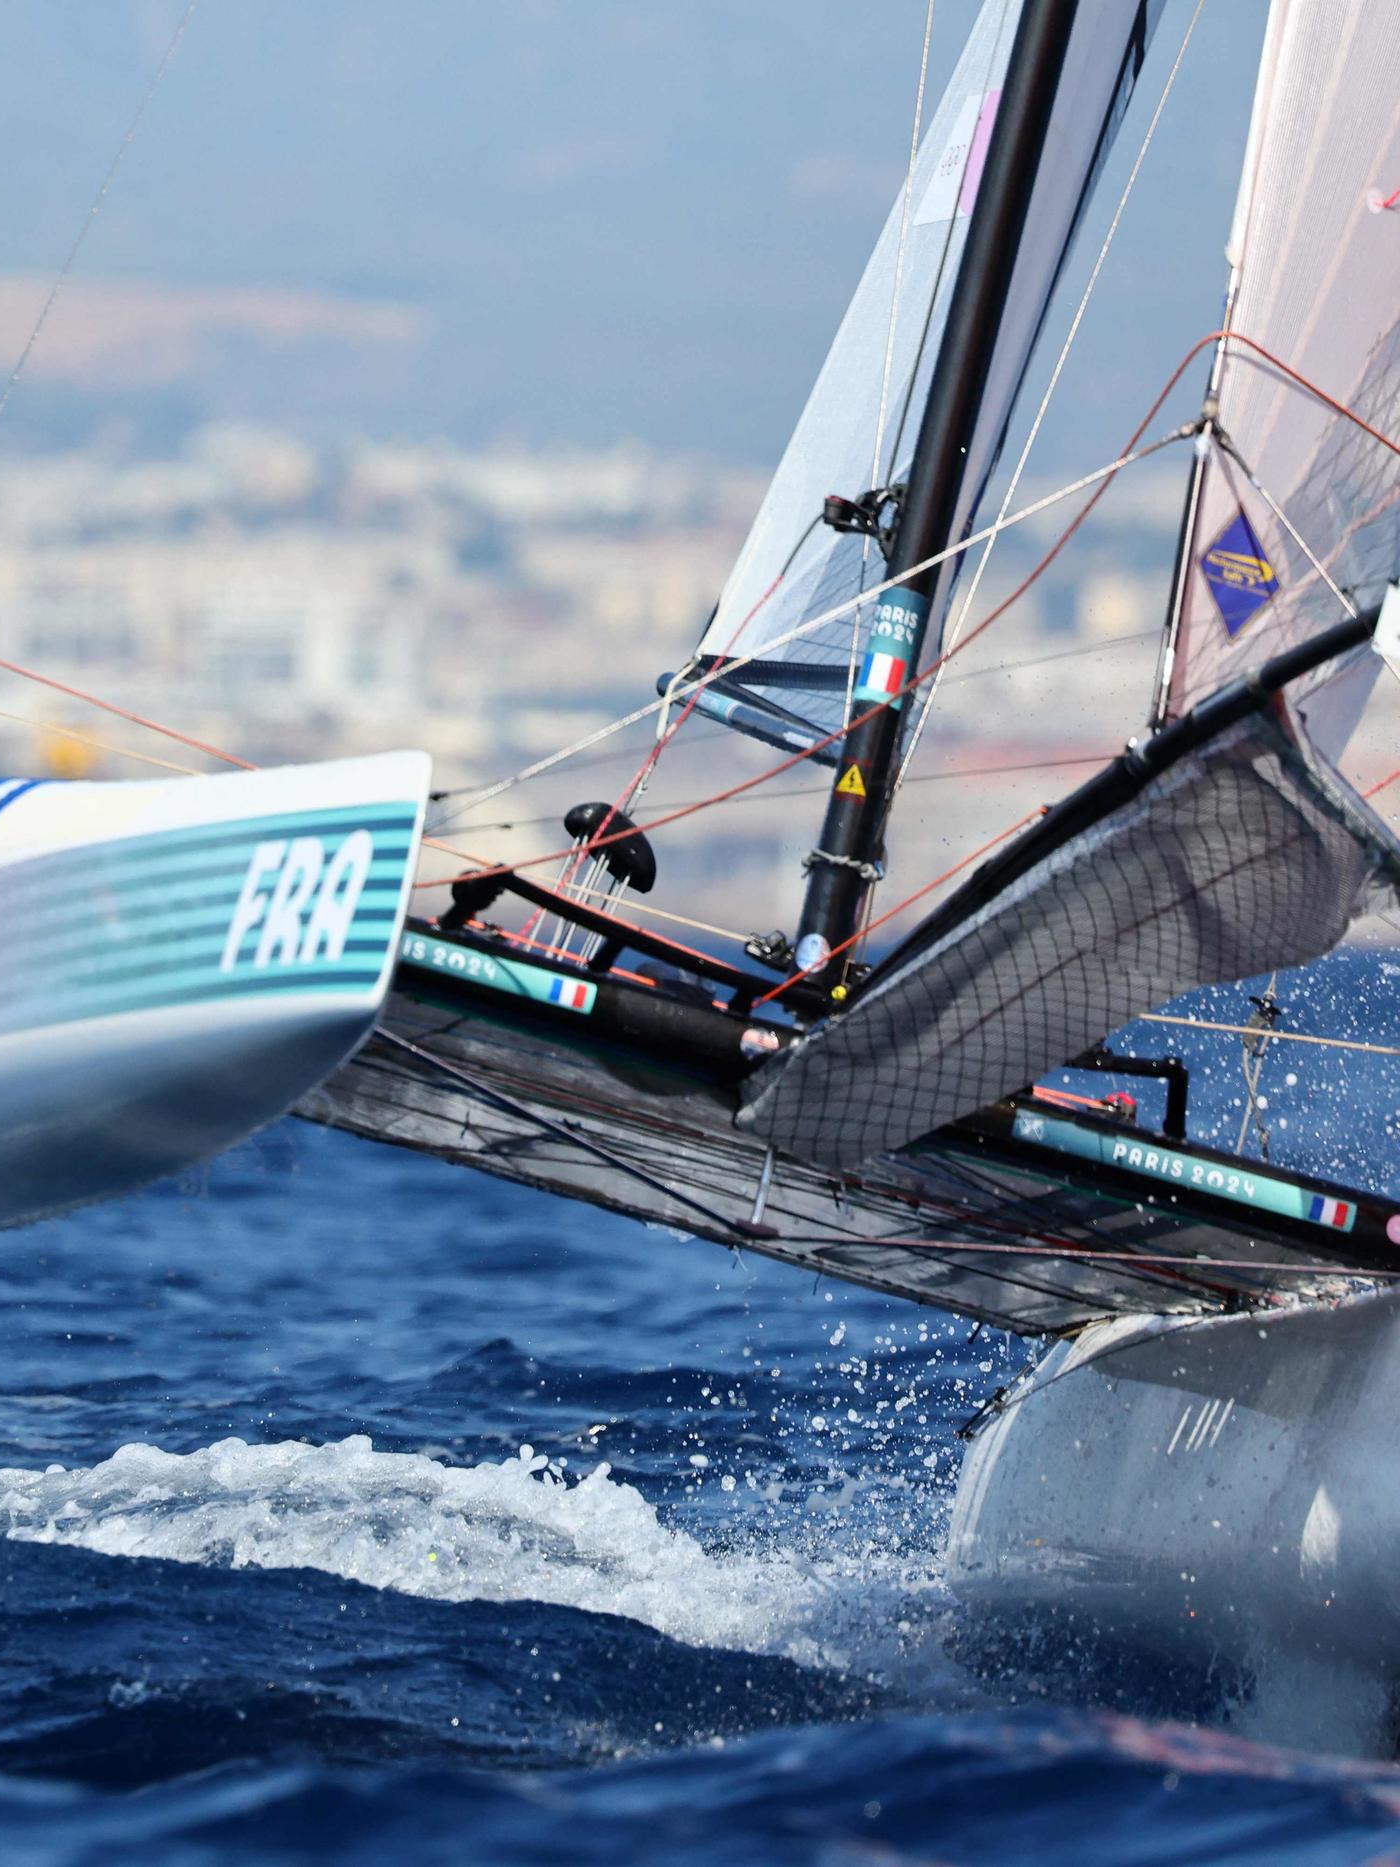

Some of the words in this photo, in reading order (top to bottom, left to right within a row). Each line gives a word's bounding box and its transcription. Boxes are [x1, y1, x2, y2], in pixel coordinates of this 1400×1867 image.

[219, 828, 374, 974] FRA
[431, 946, 496, 981] 2024
[1112, 1142, 1184, 1178] PARIS
[1191, 1164, 1256, 1199] 2024
